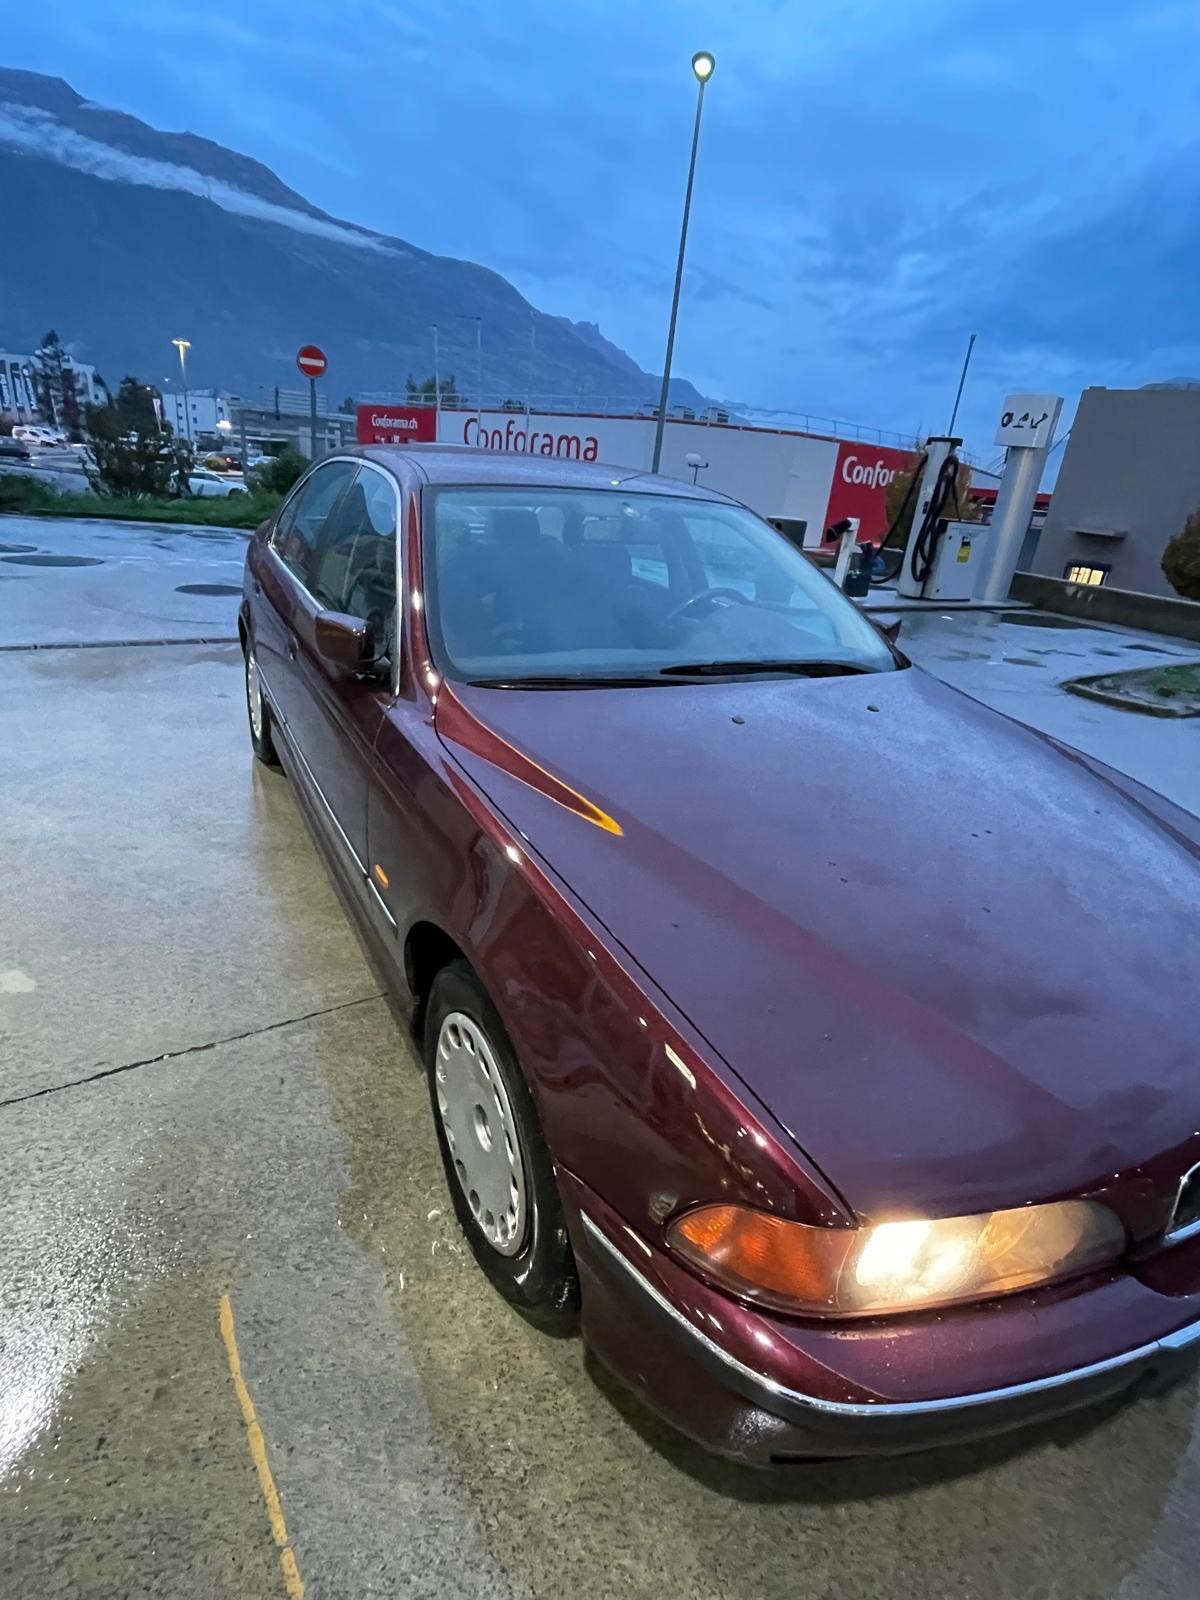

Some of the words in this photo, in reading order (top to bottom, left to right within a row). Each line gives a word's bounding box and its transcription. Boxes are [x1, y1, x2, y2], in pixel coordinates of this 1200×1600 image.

[371, 414, 418, 429] Conforama.ch
[464, 417, 599, 462] Conforama
[842, 455, 896, 489] Confor
